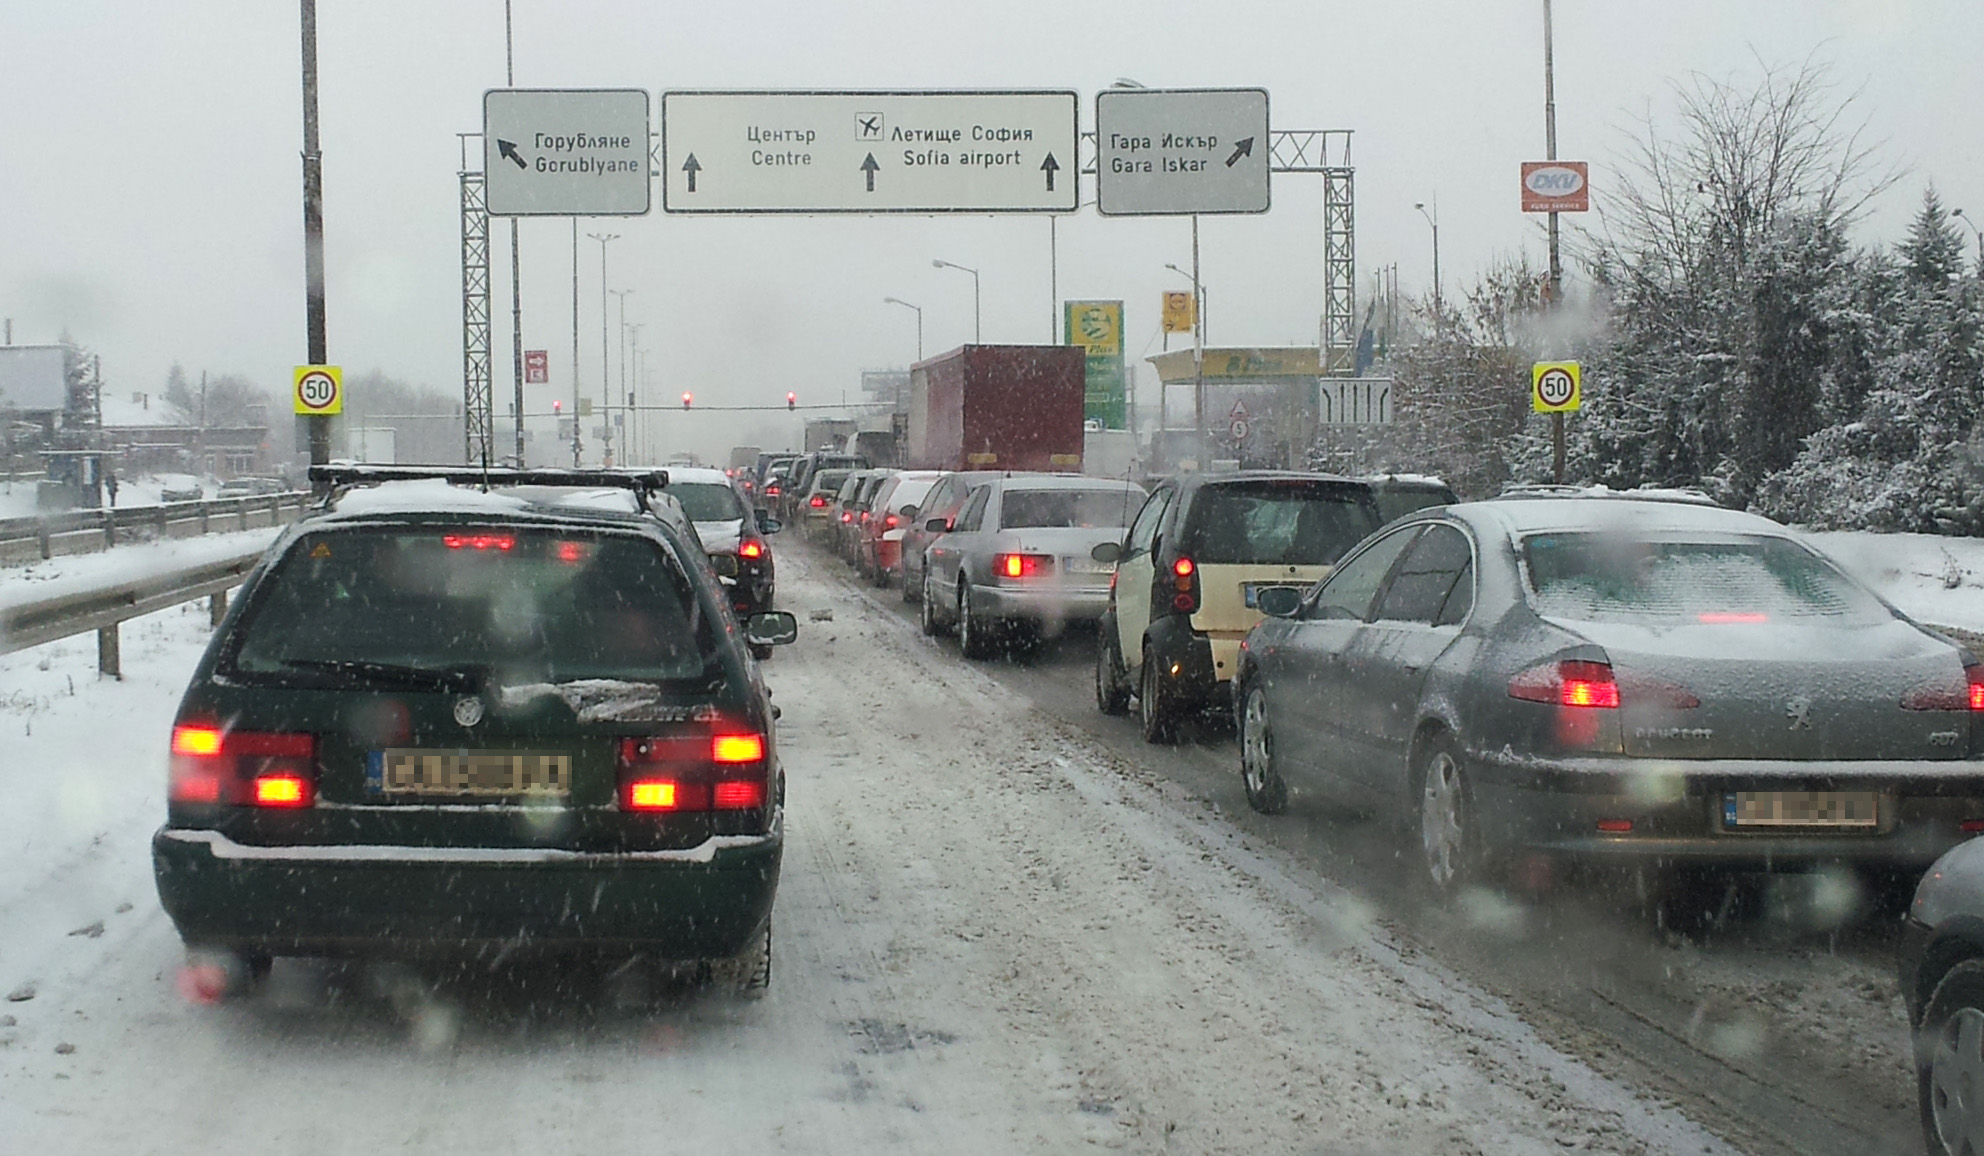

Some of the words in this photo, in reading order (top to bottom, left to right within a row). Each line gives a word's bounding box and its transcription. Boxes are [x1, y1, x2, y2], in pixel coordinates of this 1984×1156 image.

[535, 132, 631, 152] Горубляне
[747, 126, 816, 145] Център
[891, 125, 962, 144] Летище
[971, 124, 1033, 143] София
[1110, 133, 1151, 153] Гара
[1161, 132, 1218, 152] Искър
[535, 156, 639, 176] Gorublyane
[751, 149, 812, 166] Centre
[903, 149, 950, 166] Sofia
[959, 149, 1021, 169] airport
[1111, 157, 1153, 174] Gara
[1162, 156, 1208, 173] Iskar
[1532, 173, 1578, 190] DKV
[305, 379, 329, 400] 50
[1545, 376, 1568, 397] 50
[1236, 422, 1243, 435] 5
[1634, 727, 1713, 741] PEUGEOT
[1929, 731, 1959, 746] 607
